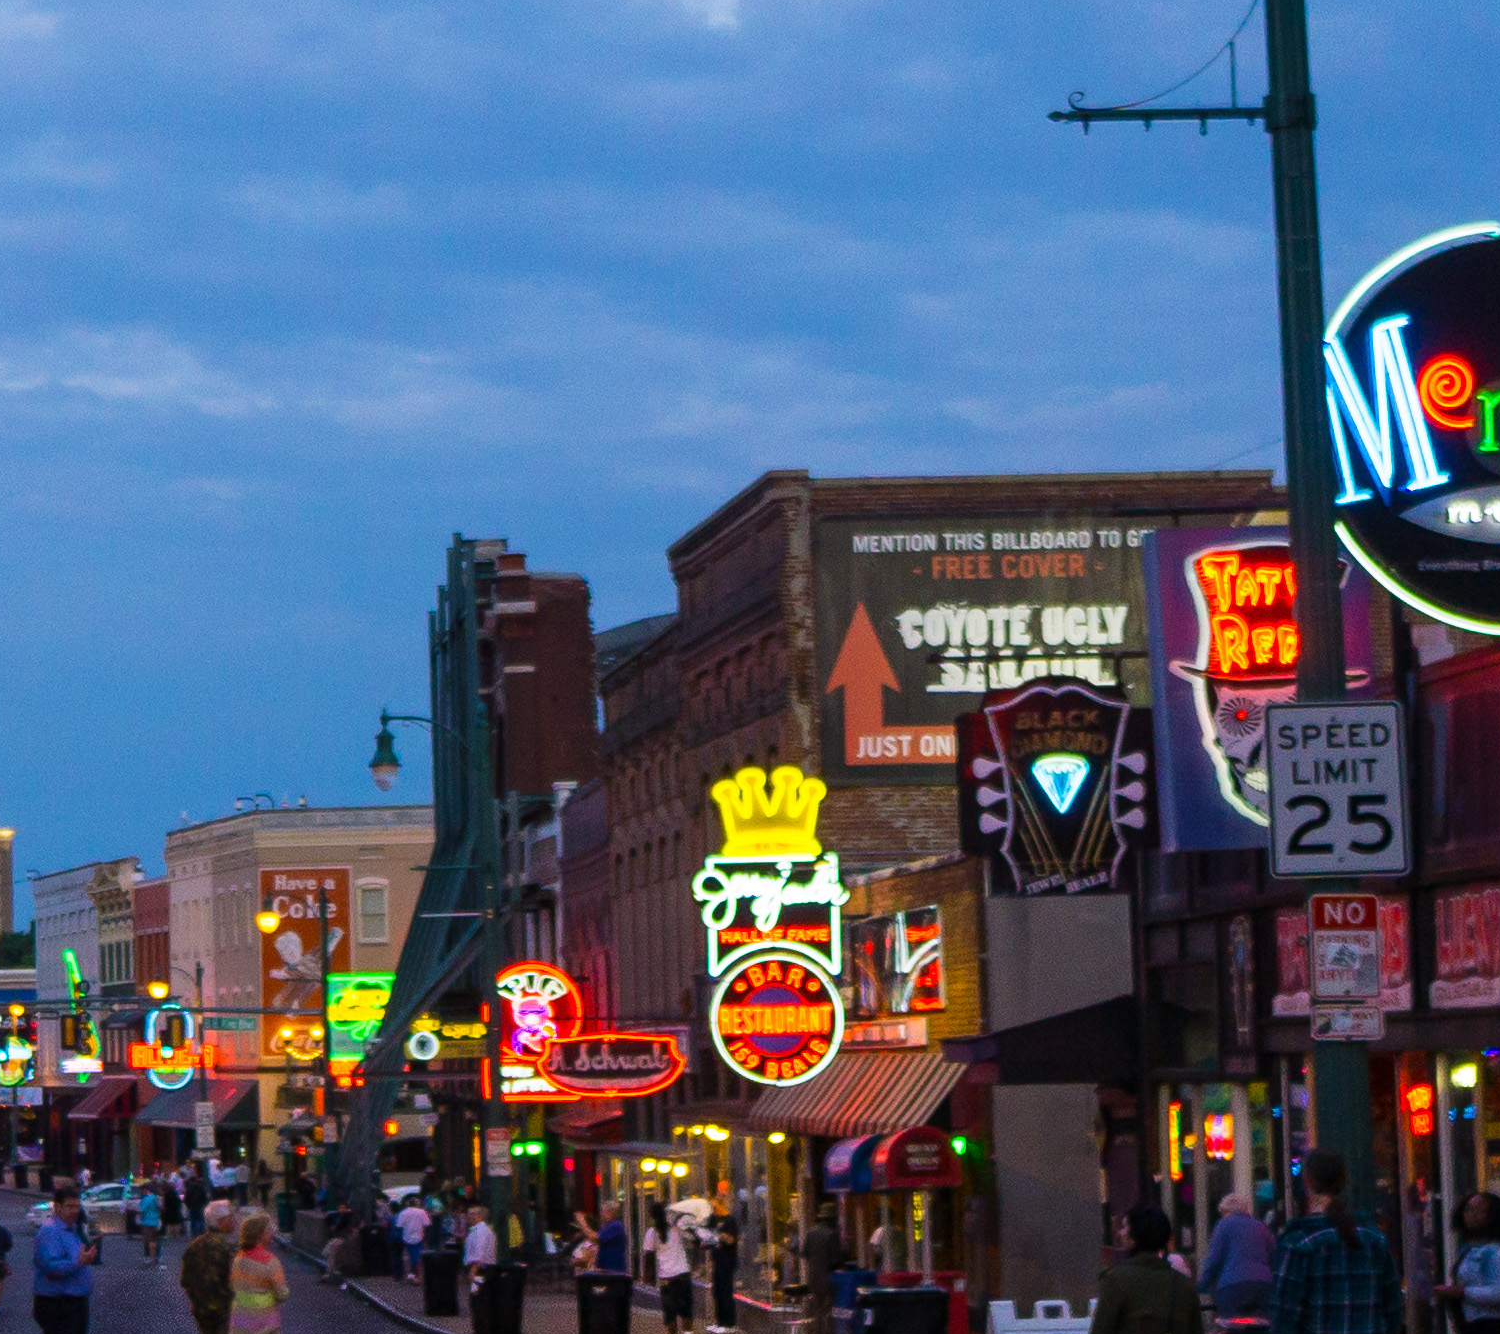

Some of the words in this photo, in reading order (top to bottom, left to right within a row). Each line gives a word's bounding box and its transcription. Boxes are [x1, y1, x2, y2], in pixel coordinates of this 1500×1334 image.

[853, 534, 937, 553] MENTION
[944, 533, 984, 551] THIS
[993, 531, 1091, 550] BILLBOARD
[1097, 531, 1121, 548] TO
[932, 556, 992, 580] FREE
[1002, 555, 1084, 578] COVER
[899, 605, 1031, 649] COYOTE
[1042, 605, 1128, 645] UGLY
[1015, 710, 1099, 730] BLACK
[857, 735, 912, 758] JUST
[1011, 731, 1108, 757] DIAMOND
[1278, 722, 1389, 749] SPEED
[1292, 758, 1377, 785] LIMIT
[1287, 795, 1392, 855] 25
[274, 875, 317, 891] Have
[323, 877, 336, 891] a
[1322, 902, 1367, 924] NO
[720, 929, 757, 944] HALL
[761, 927, 784, 942] OF
[786, 927, 830, 942] FAME
[497, 971, 568, 1001] PIG
[748, 961, 805, 988] BAR
[719, 1004, 833, 1036] RESTAURANT
[729, 1041, 760, 1069] 159
[765, 1038, 829, 1079] BEALE
